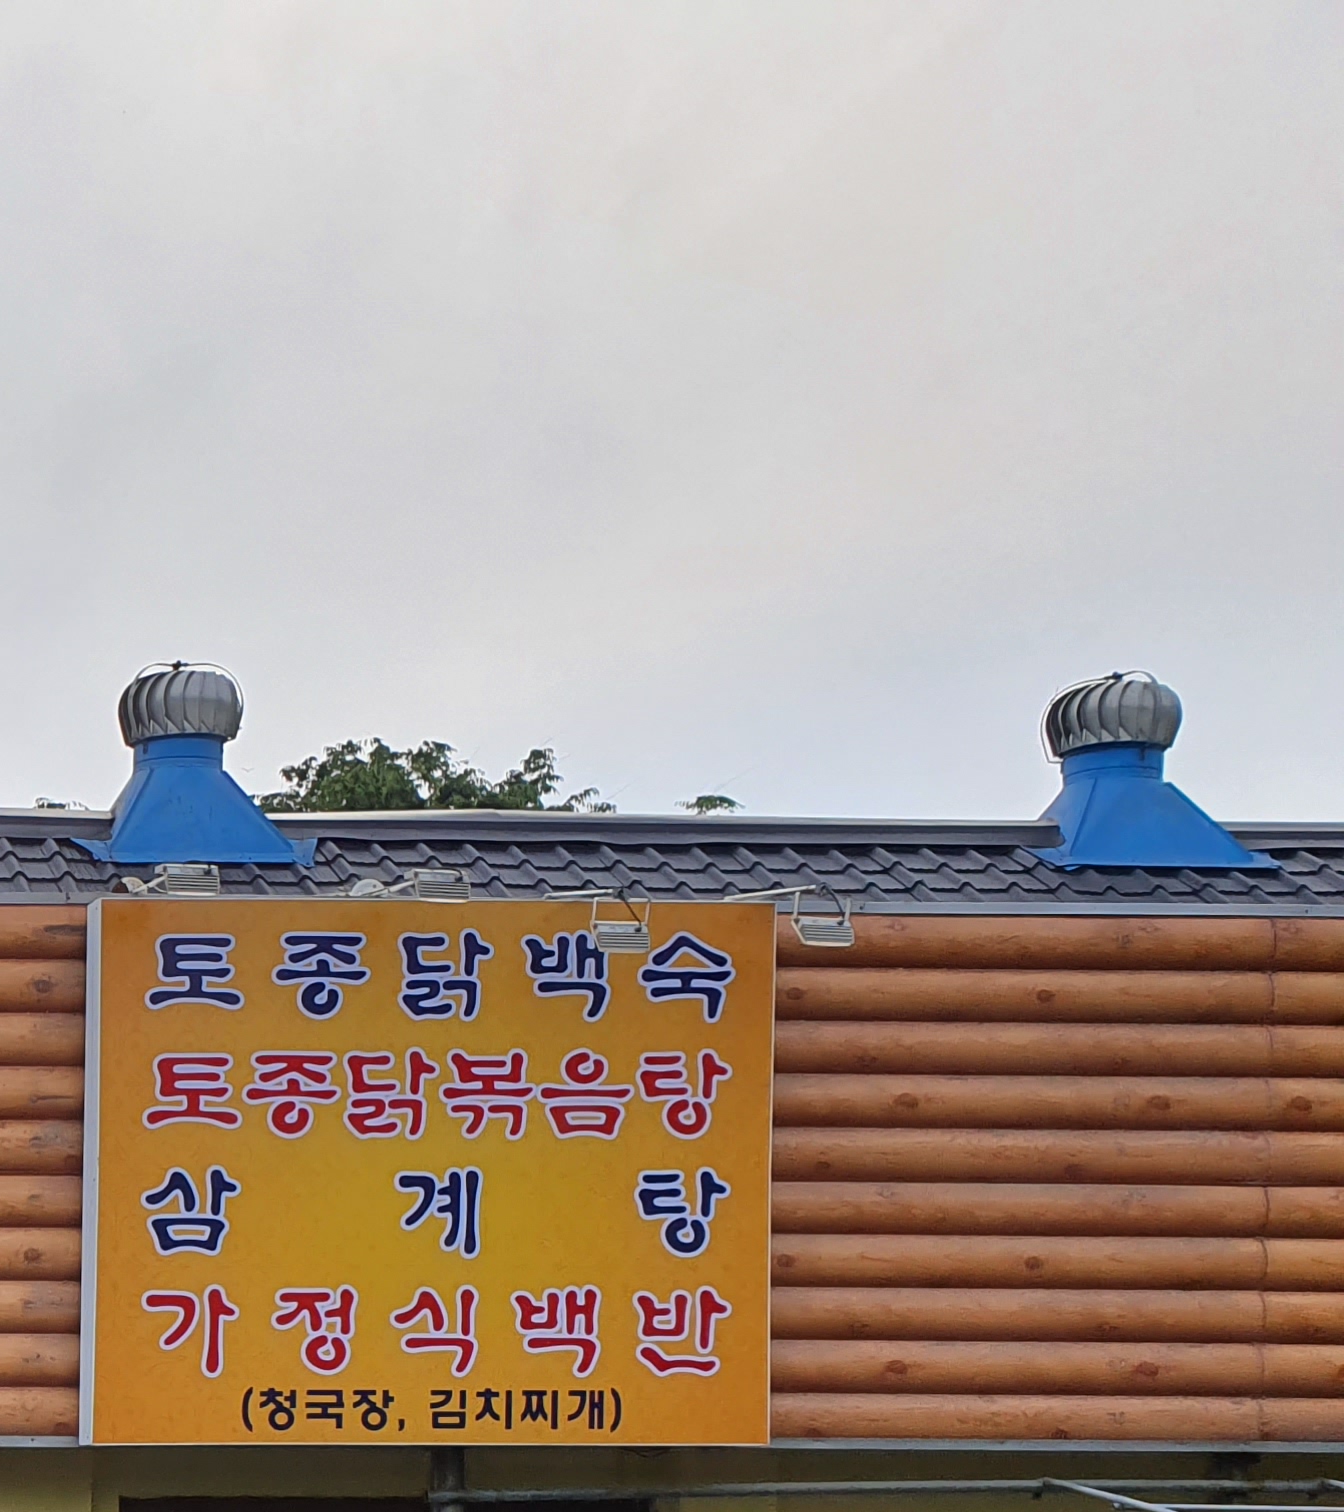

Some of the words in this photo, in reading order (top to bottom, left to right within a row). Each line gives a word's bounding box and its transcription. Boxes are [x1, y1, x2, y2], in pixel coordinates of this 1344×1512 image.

[145, 929, 736, 1022] 토종닭백숙
[143, 1048, 733, 1139] 토종닭볶음탕
[141, 1164, 730, 1258] 삼계탕
[141, 1284, 732, 1377] 가정식백반
[241, 1387, 405, 1432] (청국장,
[429, 1387, 623, 1434] 김치찌개)
